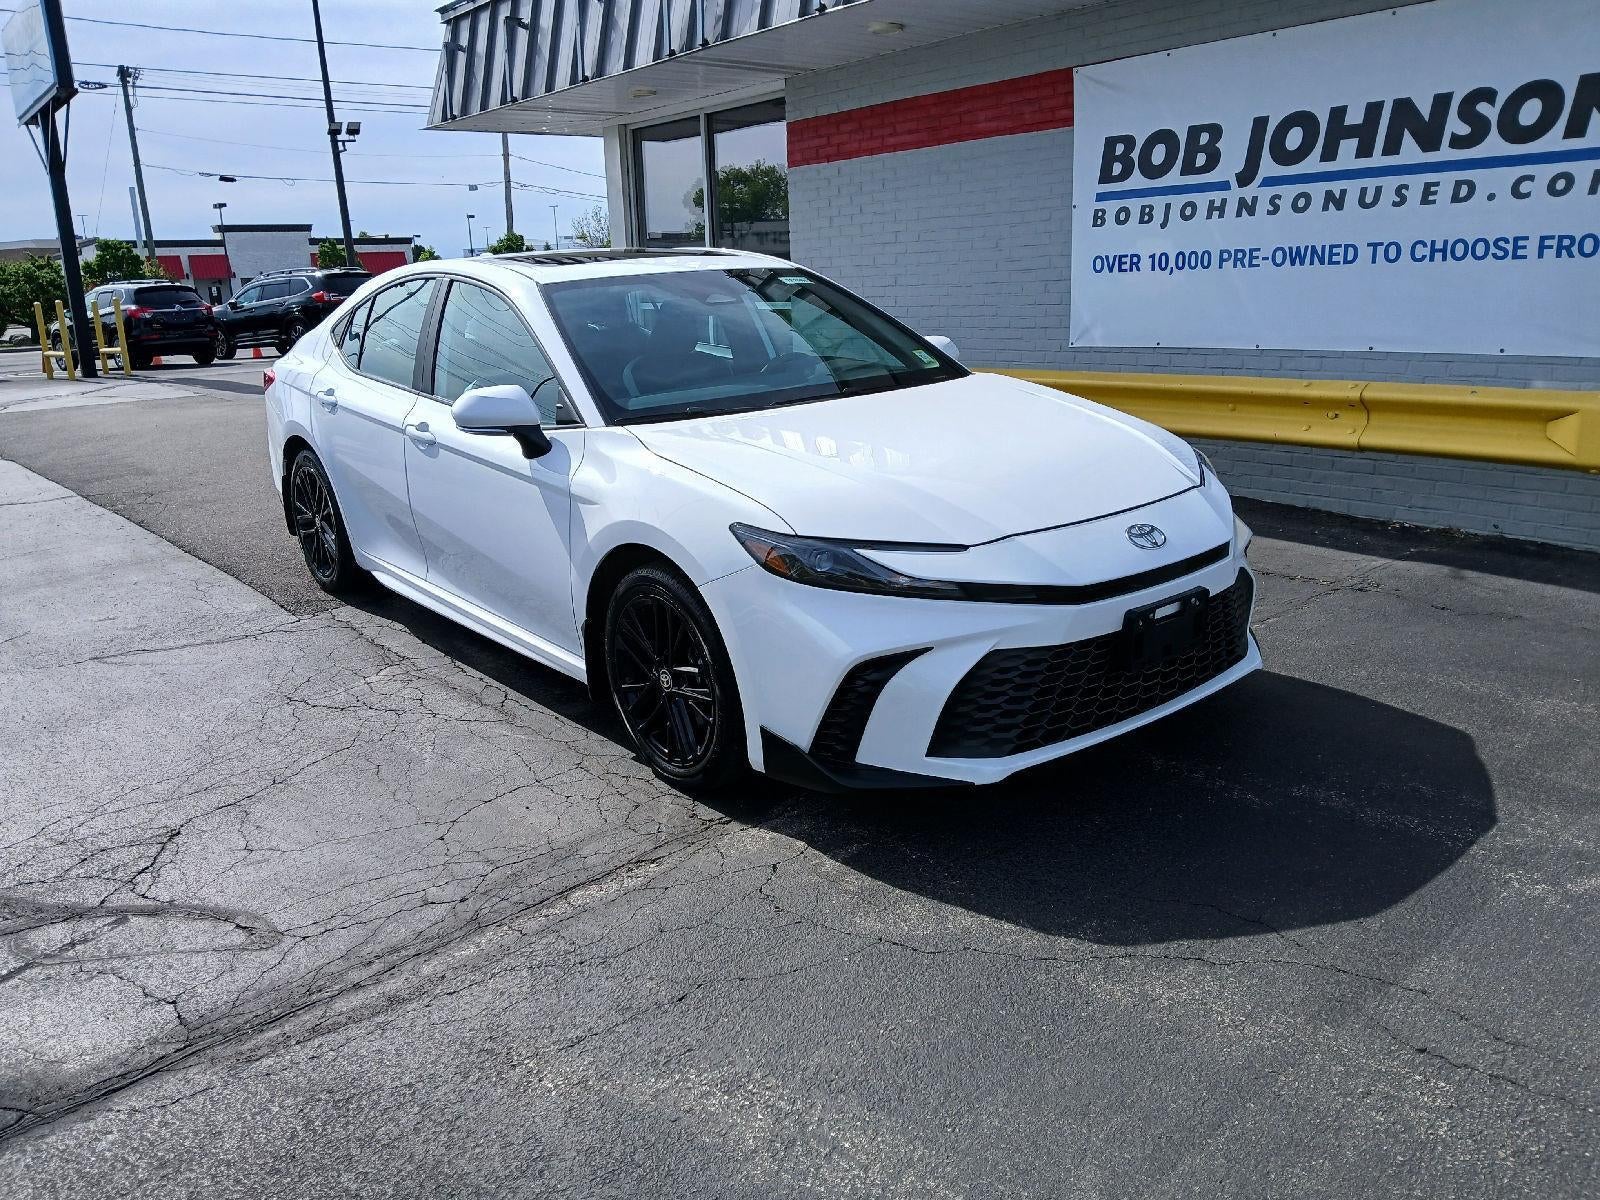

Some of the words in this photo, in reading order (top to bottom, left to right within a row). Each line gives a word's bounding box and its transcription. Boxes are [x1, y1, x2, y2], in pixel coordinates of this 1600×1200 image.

[1098, 123, 1223, 185] BOB
[1092, 254, 1142, 274] OVER
[1148, 249, 1212, 275] 10,000
[1218, 244, 1359, 269] PRE-OWNED
[1366, 241, 1402, 264] TO
[1409, 235, 1530, 263] CHOOSE
